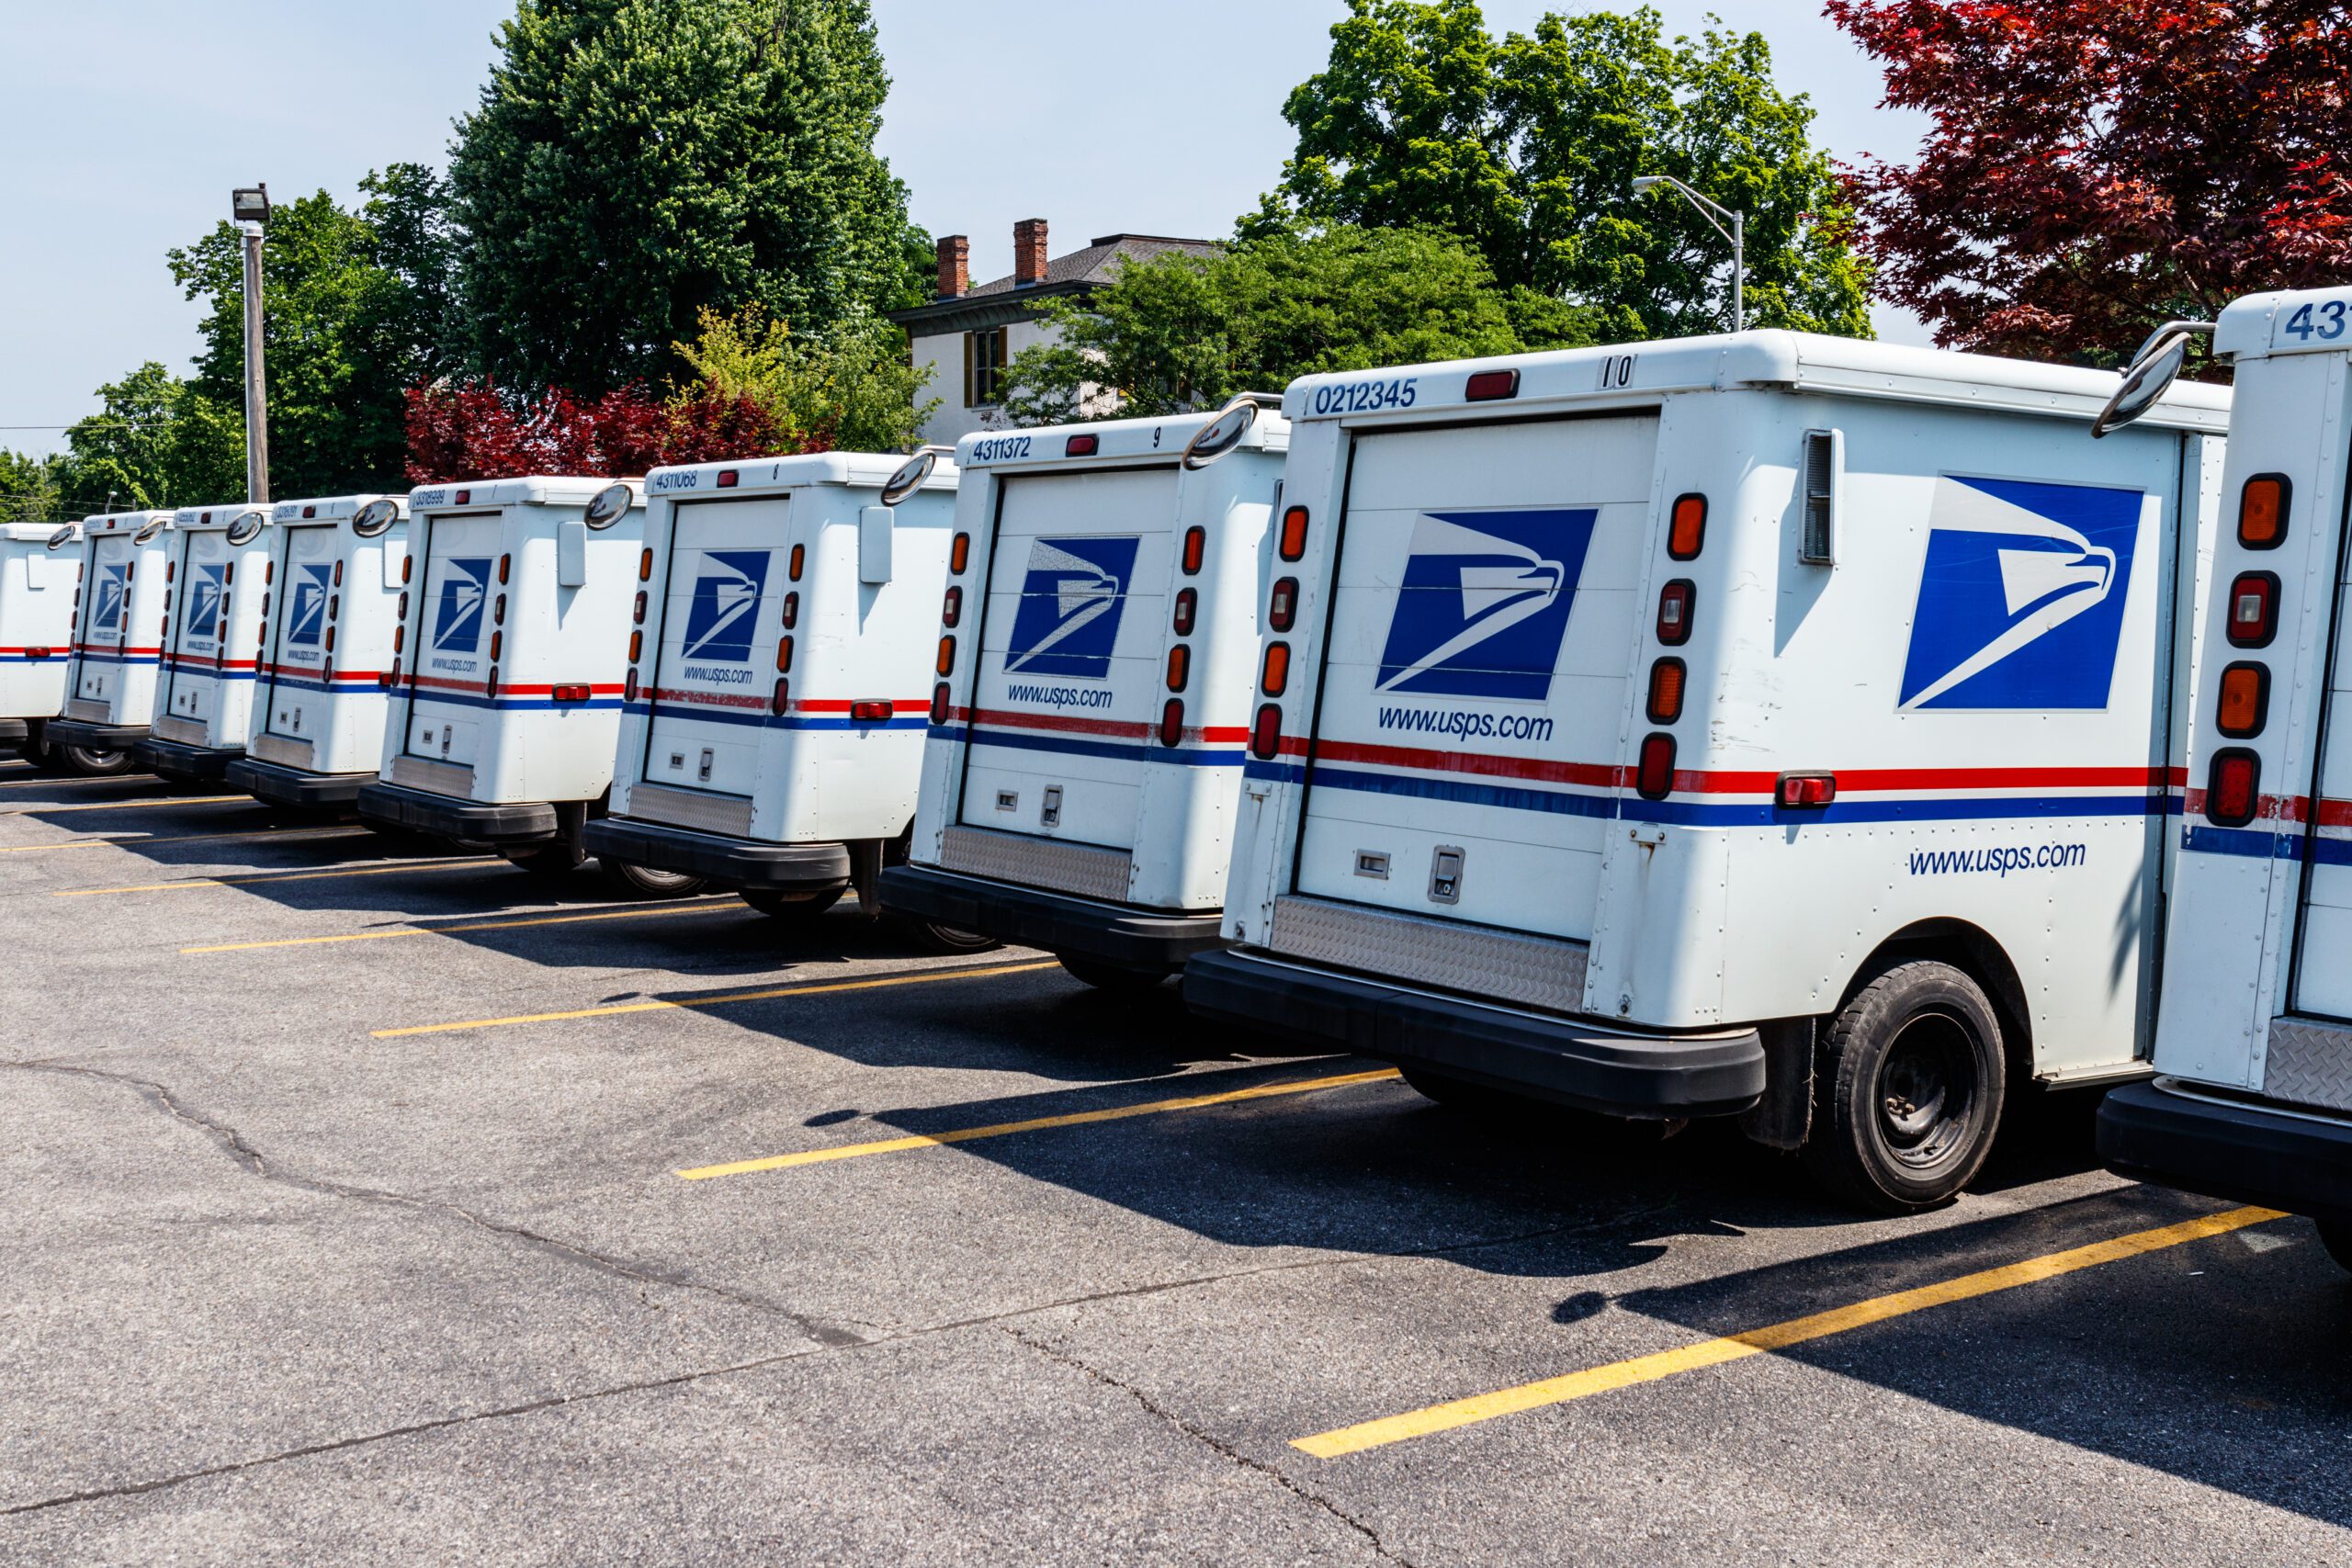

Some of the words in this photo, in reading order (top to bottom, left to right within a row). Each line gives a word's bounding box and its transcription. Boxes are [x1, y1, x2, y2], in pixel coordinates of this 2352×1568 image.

[2286, 300, 2352, 340] 43
[1602, 355, 1632, 388] 10
[1316, 378, 1418, 414] 0212345
[973, 436, 1031, 460] 4311372
[1153, 426, 1161, 448] 9
[656, 469, 698, 489] 4311068
[288, 649, 319, 663] www.usps.com
[431, 657, 477, 674] www.usps.com
[684, 666, 752, 686] www.usps.com
[1008, 683, 1113, 710] www.usps.com
[1378, 706, 1553, 742] www.usps.com
[1909, 840, 2086, 878] www.usps.com
